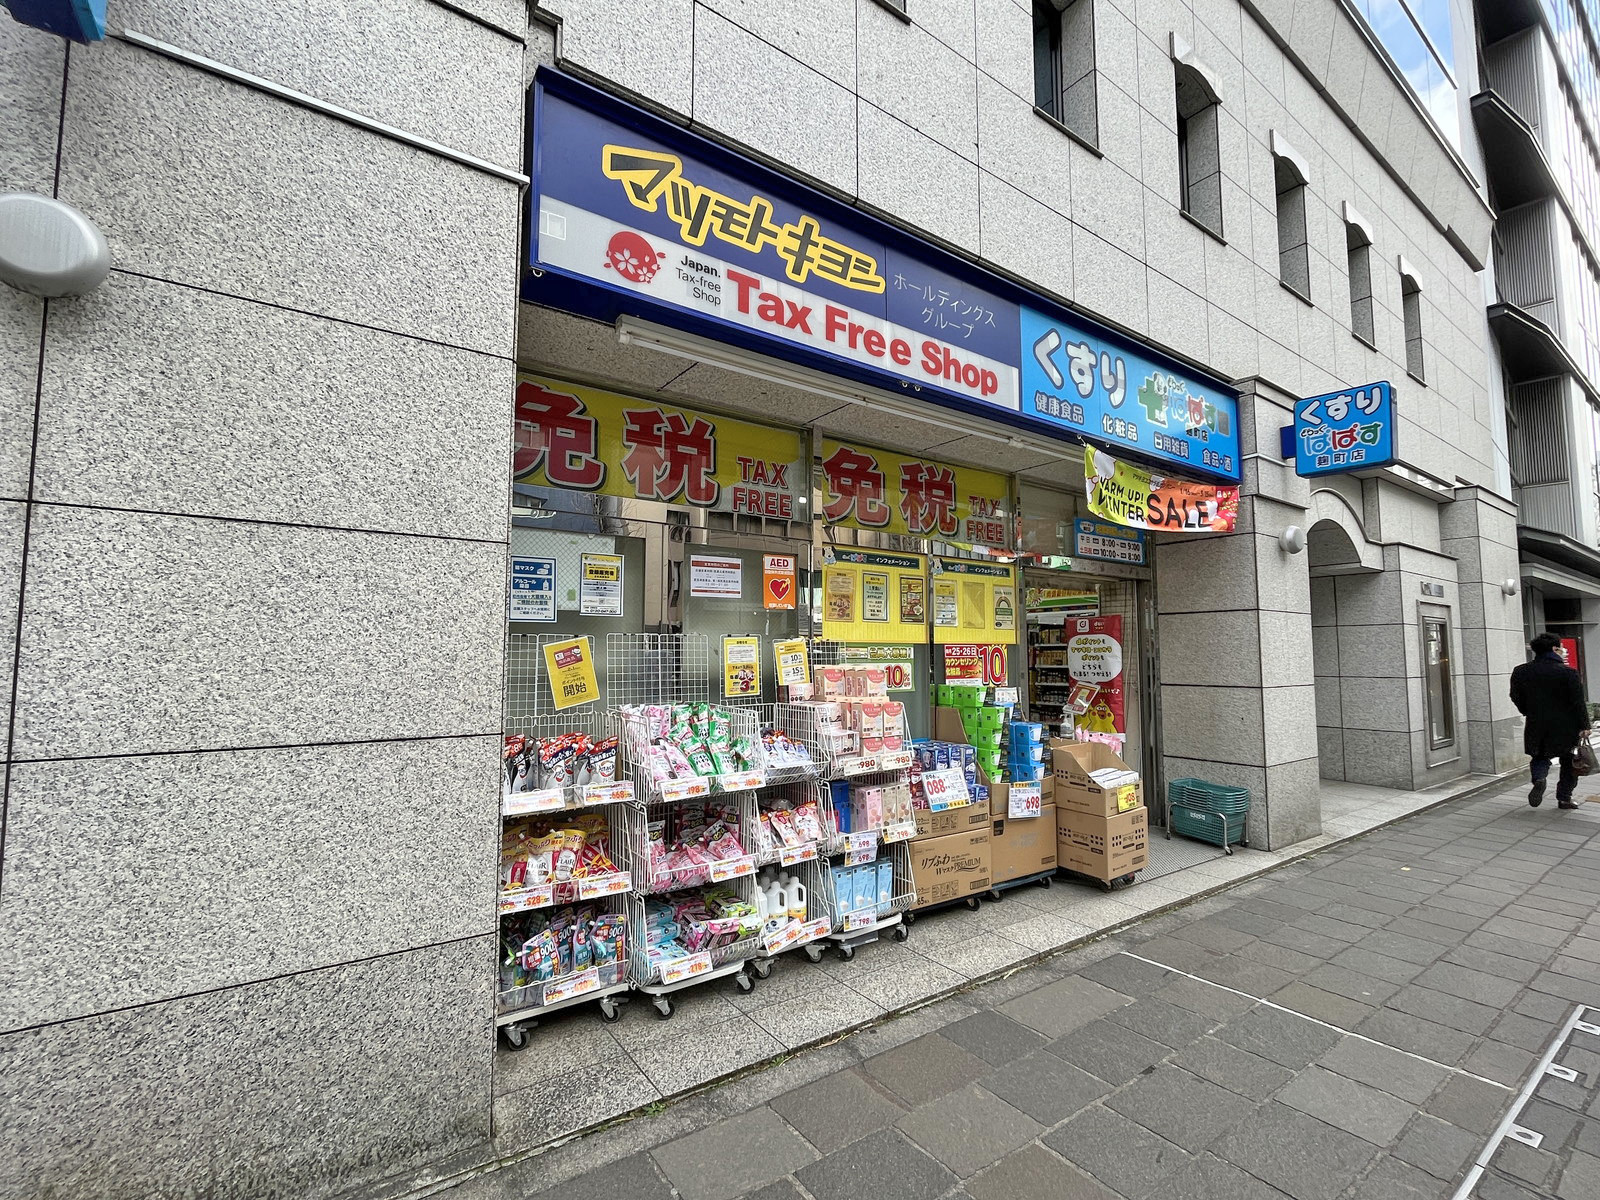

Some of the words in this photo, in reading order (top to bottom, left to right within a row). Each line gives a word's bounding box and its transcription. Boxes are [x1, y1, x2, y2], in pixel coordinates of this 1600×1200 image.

[602, 144, 885, 294] マツモトキヨシ
[675, 268, 721, 292] Tax-free
[681, 255, 721, 278] Japan.
[693, 287, 721, 306] Shop
[894, 273, 997, 328] ホールディングス
[726, 269, 812, 335] Tax
[826, 304, 912, 367] Free
[921, 341, 999, 396] Shop
[921, 308, 975, 339] グループ
[1033, 328, 1127, 409] くすり
[1034, 390, 1084, 425] 健康食品
[1299, 386, 1382, 426] くすり
[1102, 414, 1138, 442] 化粧品
[1304, 422, 1383, 456] ぱぱす
[513, 380, 721, 508] 免税
[1154, 431, 1190, 459] 日用雑貨
[737, 456, 789, 490] TAX
[732, 486, 793, 519] FREE
[822, 447, 959, 537] 免税
[1127, 489, 1145, 505] UP!
[969, 495, 1001, 520] TAX
[1146, 494, 1211, 529] SALE
[966, 519, 1005, 544] FREE
[1101, 538, 1116, 548] 8:00
[769, 558, 789, 568] AED
[1100, 548, 1117, 558] 10:00
[945, 658, 978, 666] カウンセリング
[978, 645, 1006, 686] 10
[563, 682, 587, 697] 開始
[860, 759, 875, 768] 980
[1026, 796, 1040, 809] 698
[526, 895, 540, 906] 528
[540, 941, 554, 958] 900
